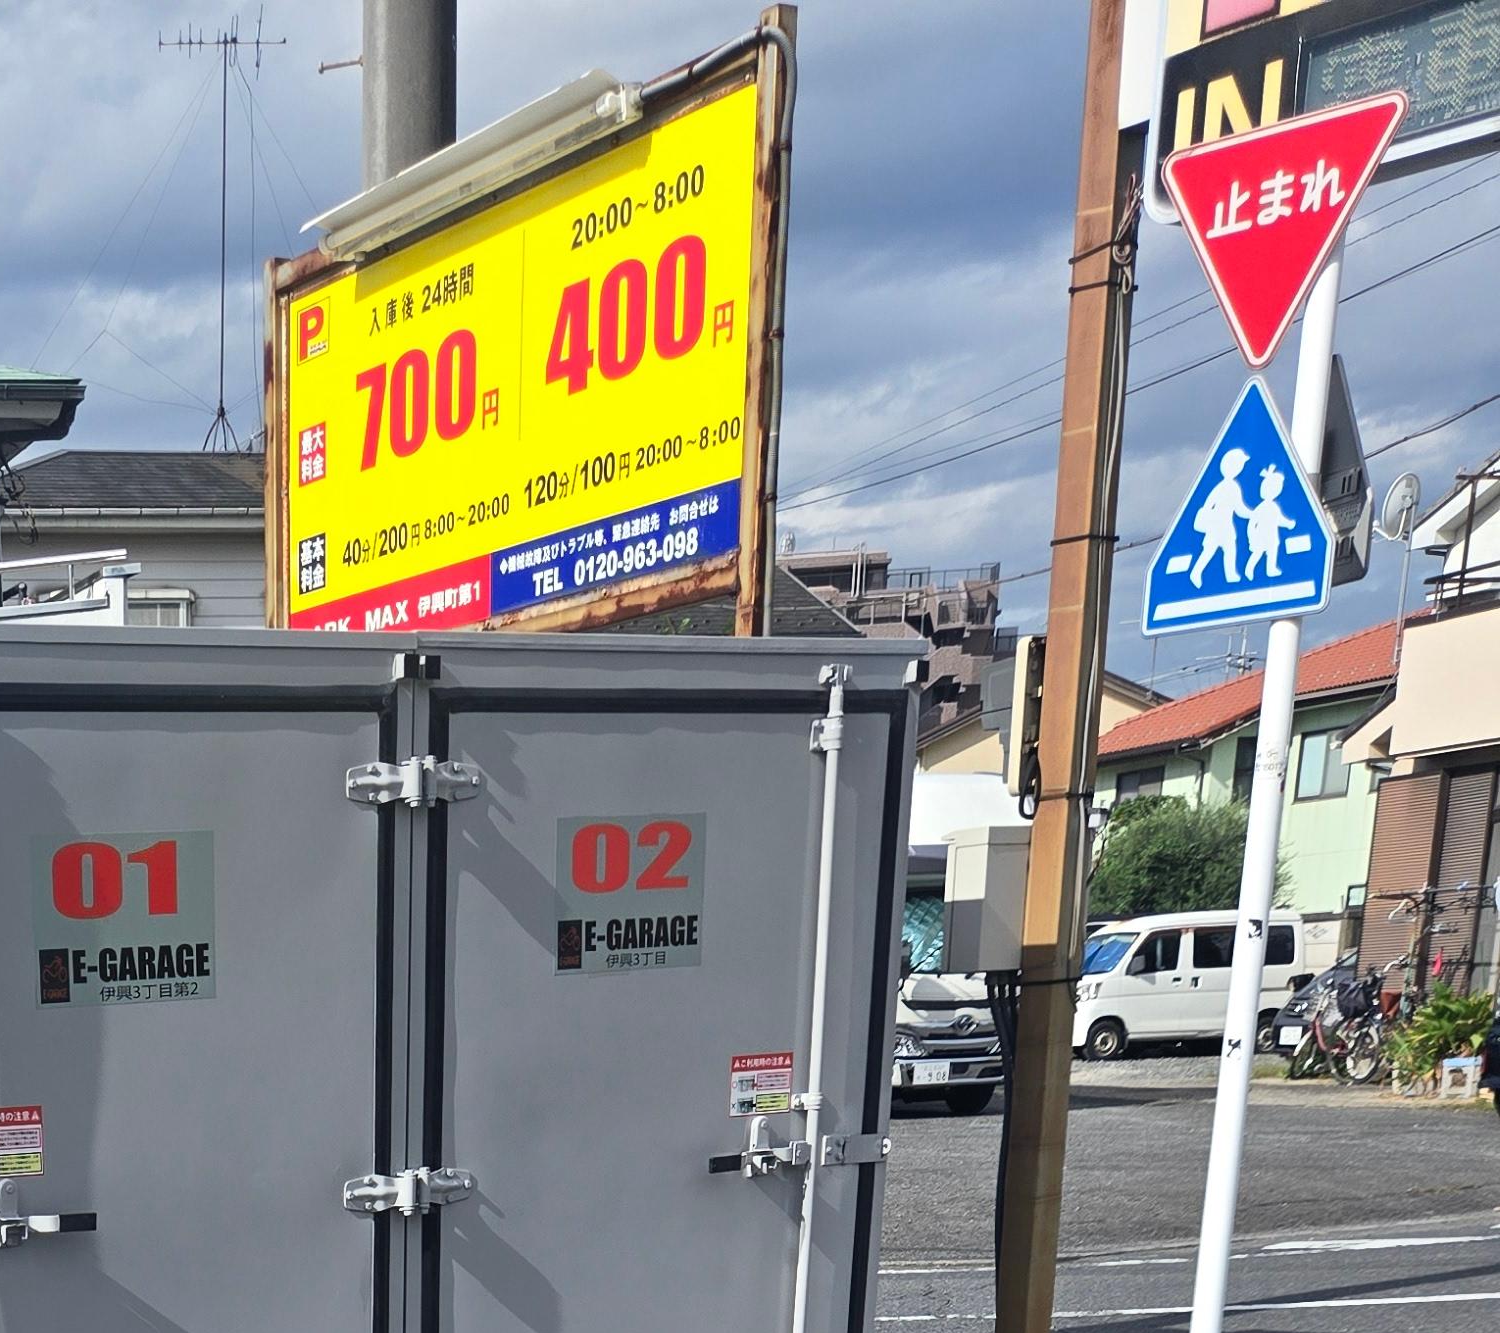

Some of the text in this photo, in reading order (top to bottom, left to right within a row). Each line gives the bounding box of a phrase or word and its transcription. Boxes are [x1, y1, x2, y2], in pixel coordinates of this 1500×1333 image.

[1174, 59, 1283, 150] IN
[1206, 159, 1345, 239] 止まれ
[369, 262, 474, 336] 入庫後 24時間
[299, 305, 325, 363] P
[301, 427, 325, 456] 最大
[301, 454, 325, 483] 料金
[524, 452, 631, 509] 120分/100円
[668, 494, 720, 526] お問合せは
[300, 537, 325, 566] 基本
[342, 522, 421, 567] 40分/200円
[532, 526, 699, 597] TEL 0120-963-098
[300, 563, 325, 593] 料金
[365, 600, 409, 632] MAX
[418, 580, 481, 618] 伊興町第1
[571, 820, 693, 894] 02
[51, 840, 179, 920] 01
[584, 914, 699, 952] E-GARAGE
[72, 943, 211, 984] E-GARAGE
[605, 951, 666, 968] 伊興3丁目
[99, 981, 199, 1002] 伊興3丁目第2
